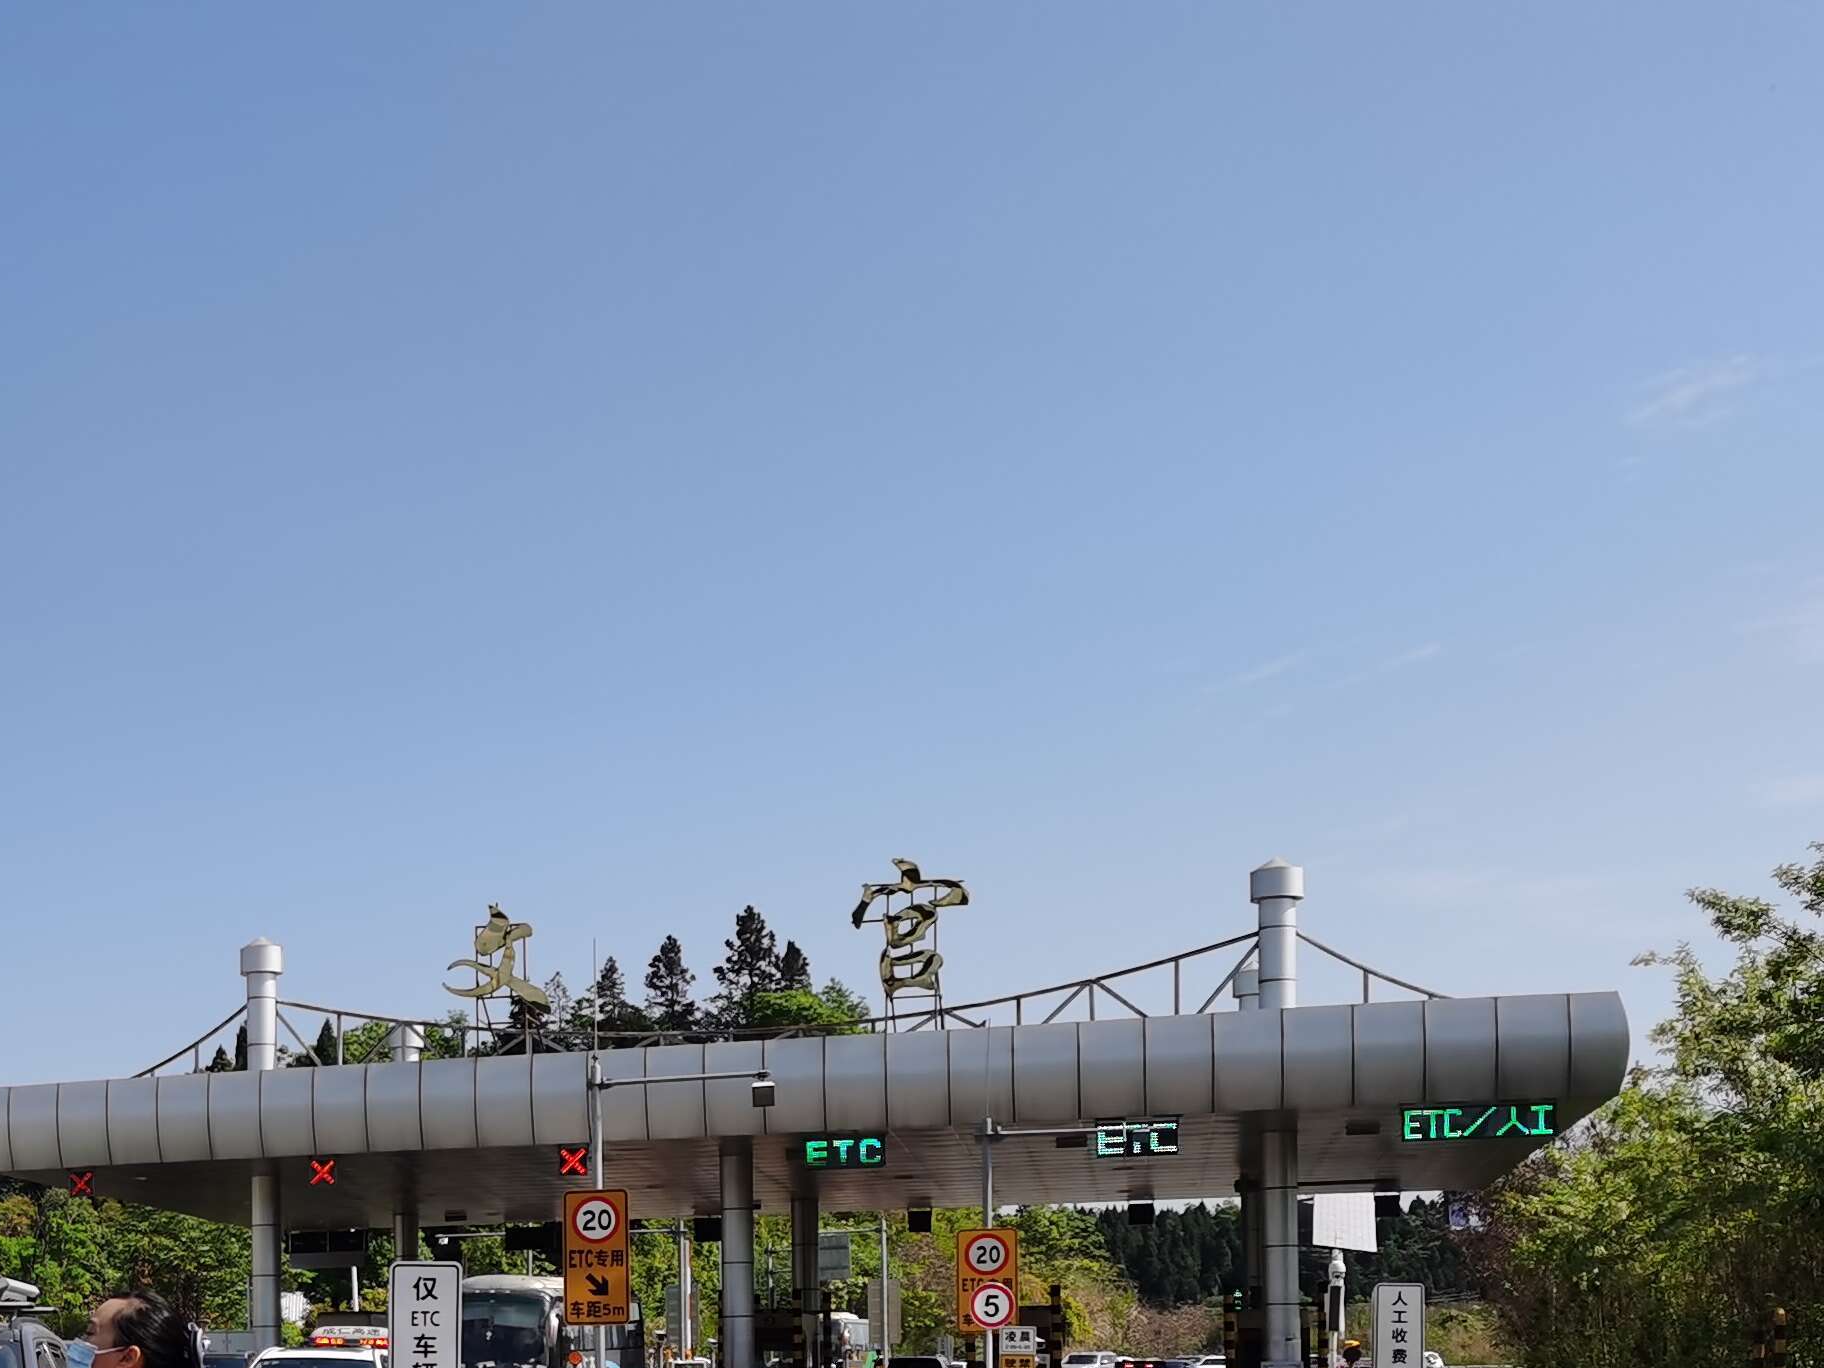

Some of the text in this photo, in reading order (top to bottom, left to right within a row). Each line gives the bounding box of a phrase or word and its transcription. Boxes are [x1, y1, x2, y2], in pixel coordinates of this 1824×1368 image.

[806, 1139, 881, 1165] ETC
[583, 1209, 612, 1231] 20
[569, 1249, 624, 1268] ETC专用
[976, 1245, 1001, 1264] 20
[570, 1301, 625, 1319] 车距5m
[984, 1295, 999, 1317] 5
